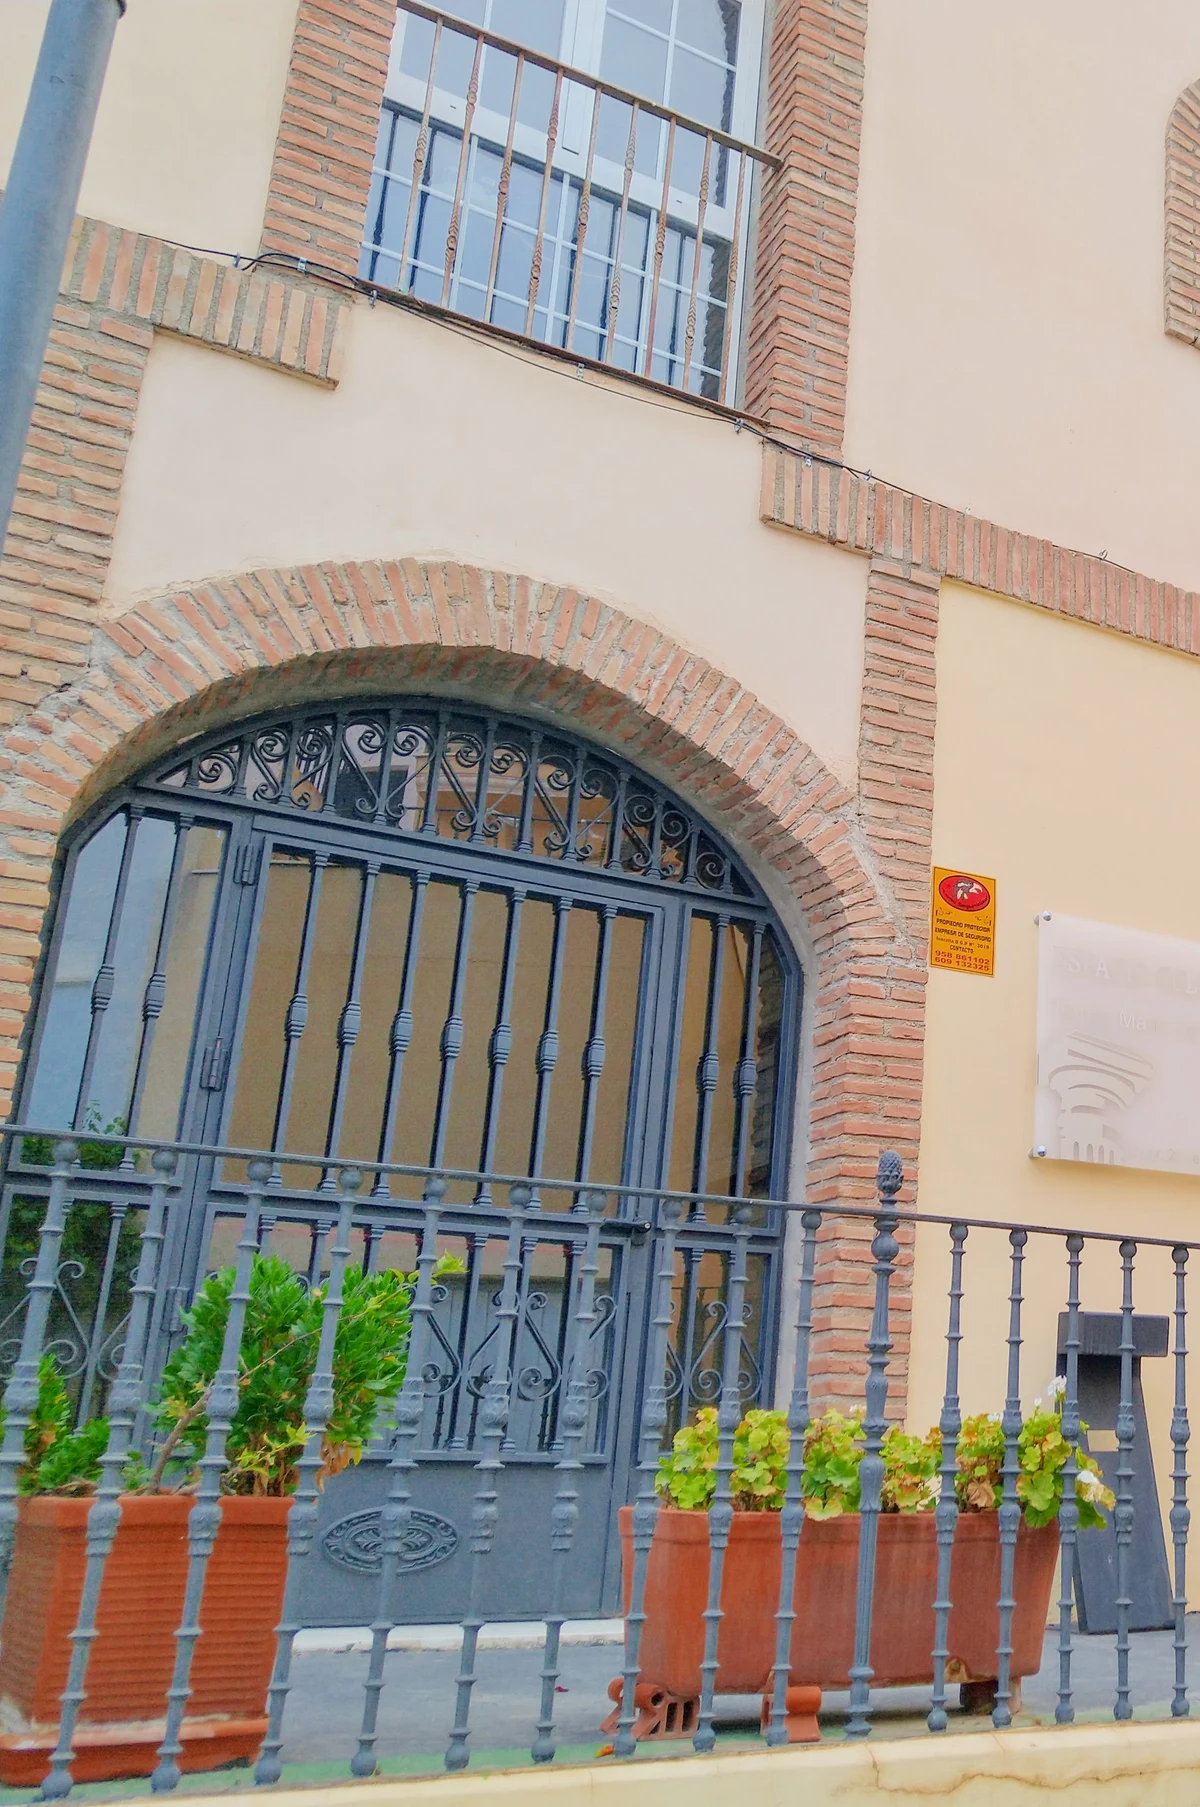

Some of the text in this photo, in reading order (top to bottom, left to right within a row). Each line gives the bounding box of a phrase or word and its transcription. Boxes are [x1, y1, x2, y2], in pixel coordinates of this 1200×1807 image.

[936, 918, 990, 933] PROPIEDAD PROTEGIDA
[935, 927, 957, 936] EMPRESA
[965, 932, 991, 942] SEGURIDAD
[949, 944, 974, 954] CONTACTO
[935, 950, 952, 959] 958
[935, 957, 952, 965] 609
